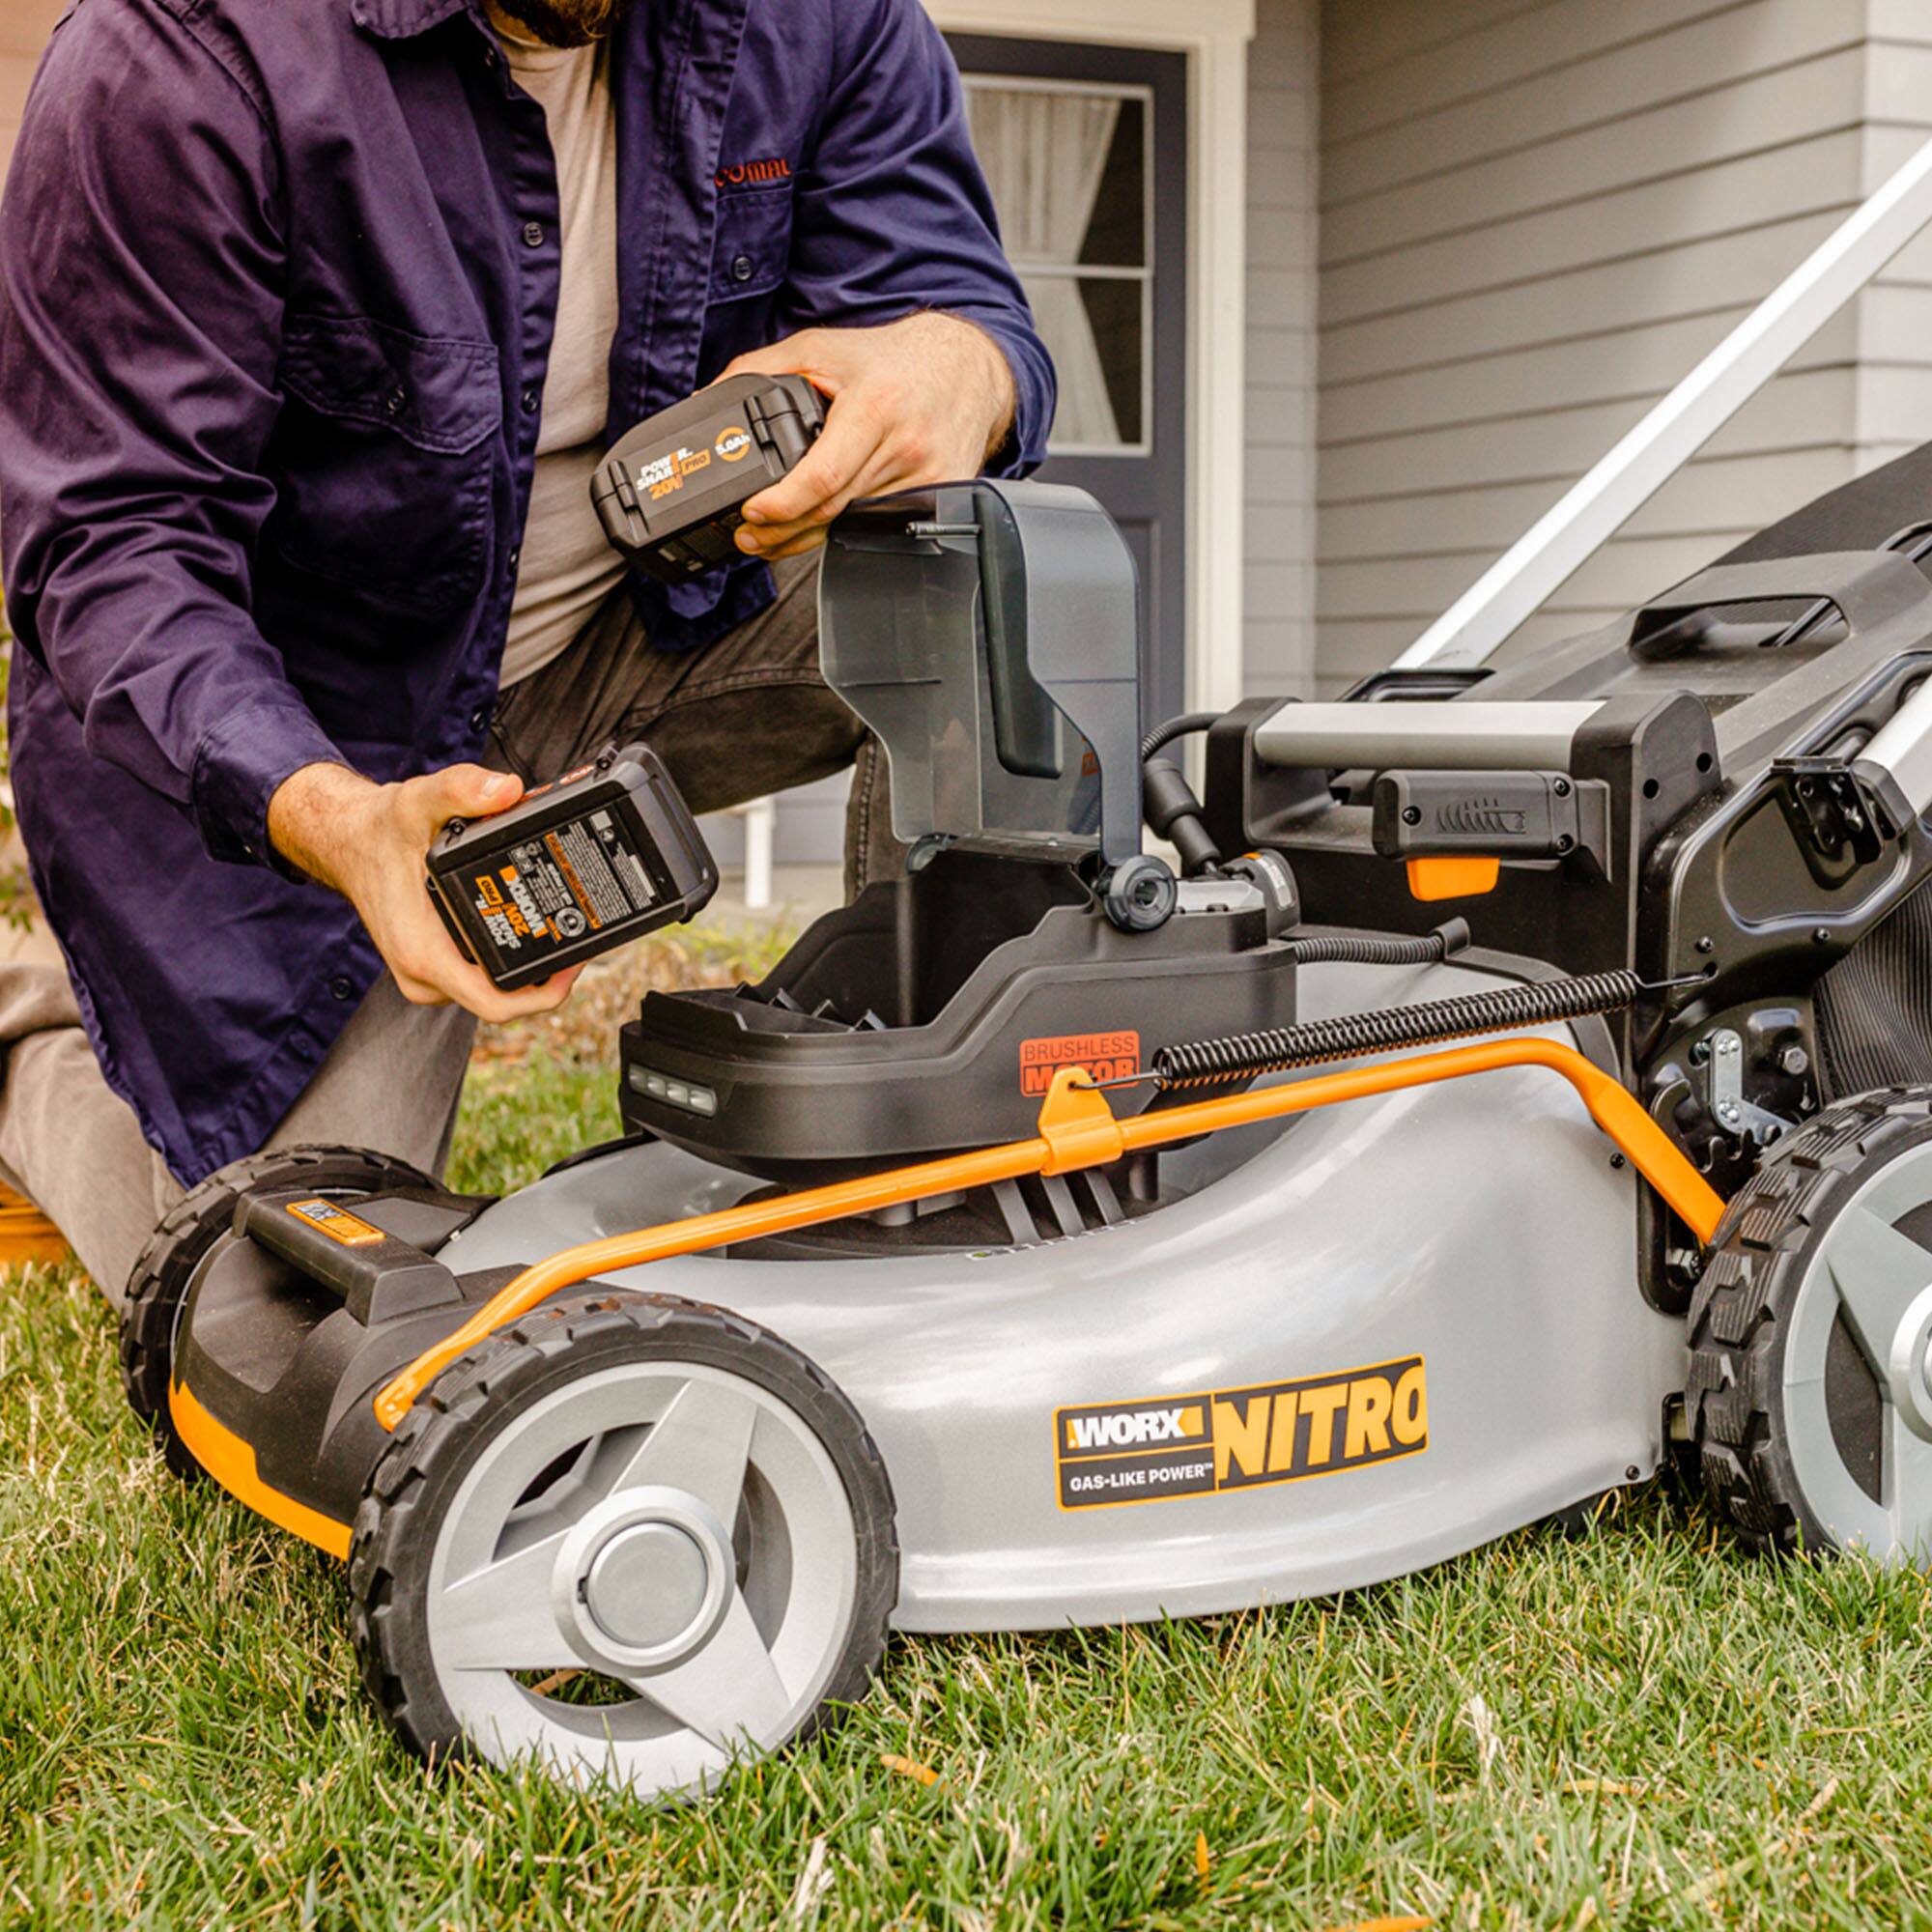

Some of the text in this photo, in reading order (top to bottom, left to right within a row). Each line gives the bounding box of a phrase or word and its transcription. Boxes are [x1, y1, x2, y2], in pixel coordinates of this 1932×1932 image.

[649, 473, 683, 500] 20V
[502, 874, 547, 937] WORX
[502, 903, 530, 937] 20V
[1024, 1036, 1135, 1062] BRUSHLESS
[1024, 1059, 1135, 1093] MOR
[1067, 1407, 1185, 1448] WORX
[1213, 1365, 1427, 1480] NITRO
[1069, 1467, 1146, 1492] GAS-LIKE
